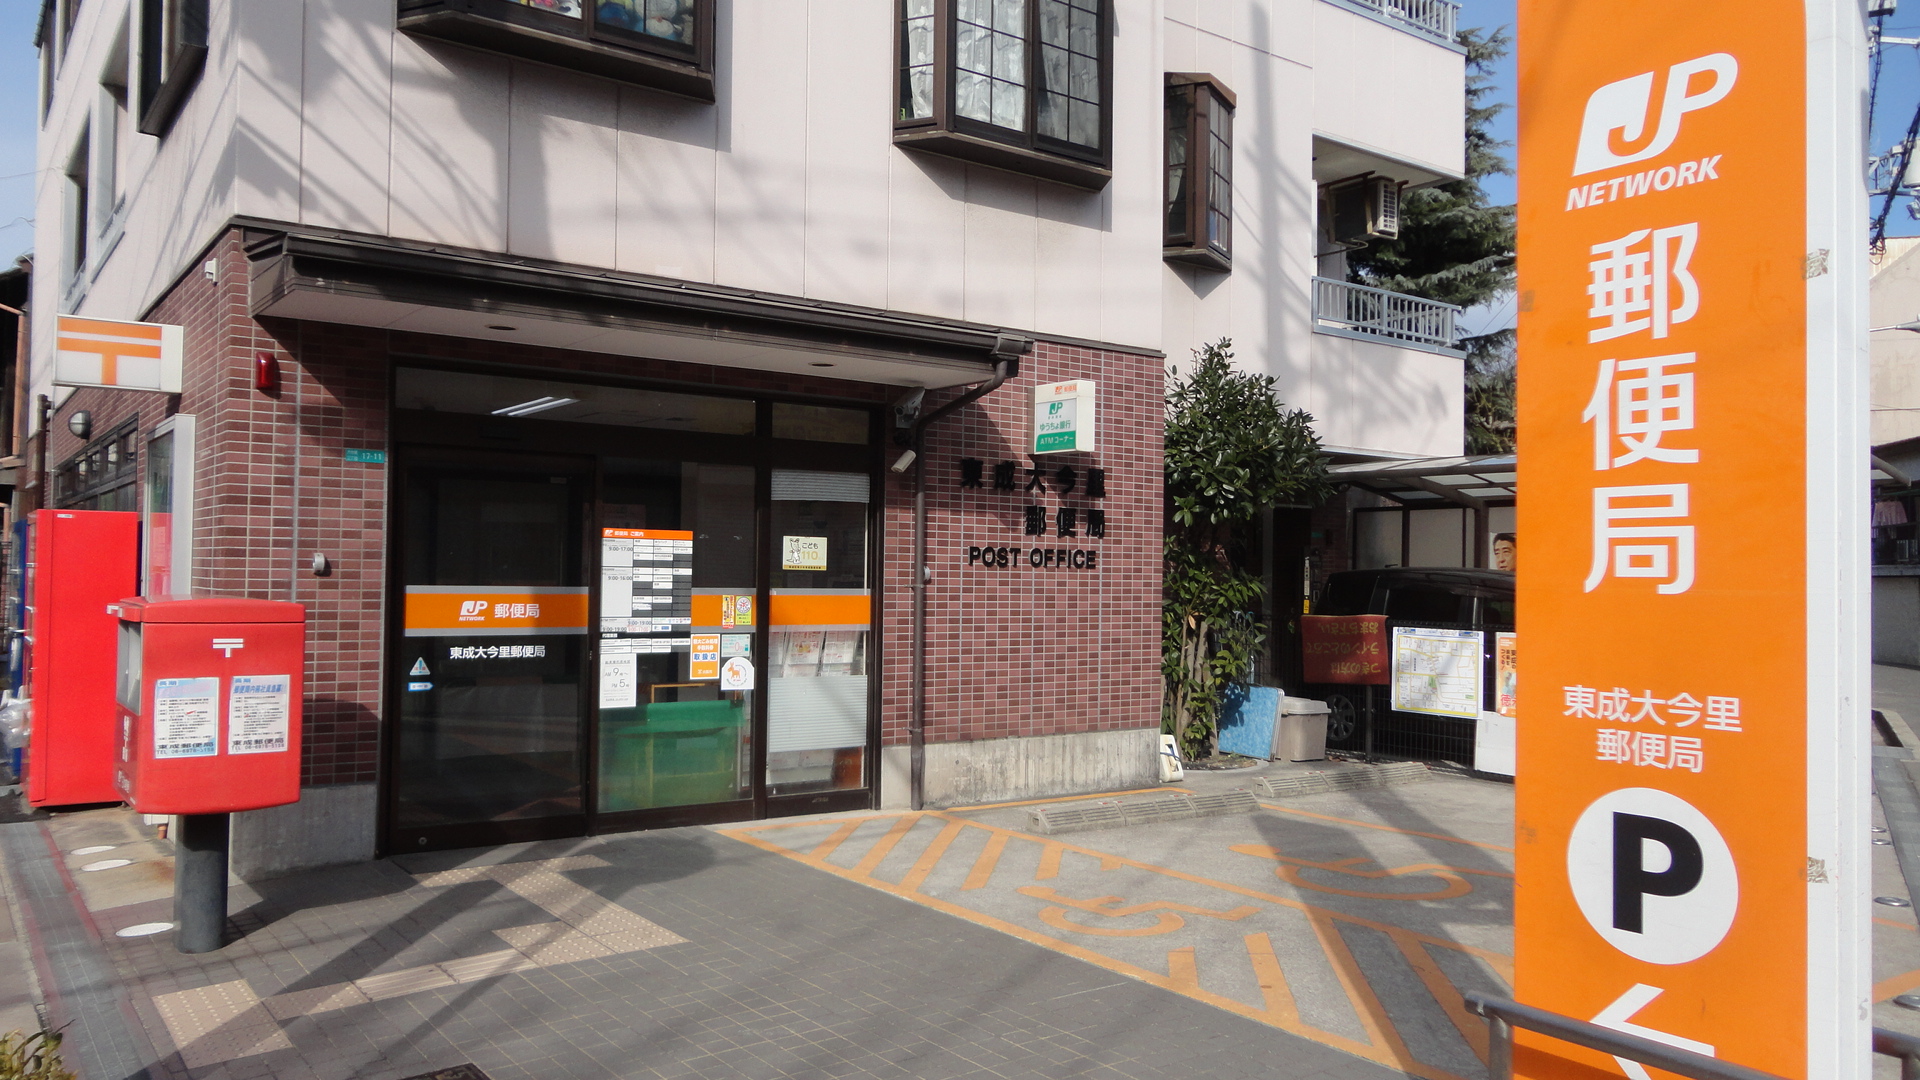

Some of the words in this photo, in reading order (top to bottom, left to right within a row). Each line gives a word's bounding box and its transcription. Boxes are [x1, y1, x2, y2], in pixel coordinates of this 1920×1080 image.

[1573, 53, 1738, 176] JP
[1566, 154, 1722, 211] NETWORK
[1049, 402, 1063, 415] JP
[1583, 222, 1699, 595] 郵便局
[1040, 420, 1071, 431] ゆうちょ銀行
[961, 458, 1105, 498] 東成大今里
[1025, 506, 1105, 538] 郵便局
[968, 547, 1021, 568] POST
[1030, 548, 1096, 569] OFFICE
[460, 600, 488, 615] JP
[494, 603, 540, 618] 郵便局
[450, 645, 545, 659] 東成大今里郵便局
[1306, 641, 1380, 655] ラインのところで
[1563, 685, 1743, 733] 東成大今里
[1597, 728, 1704, 773] 郵便局
[1613, 811, 1704, 934] P
